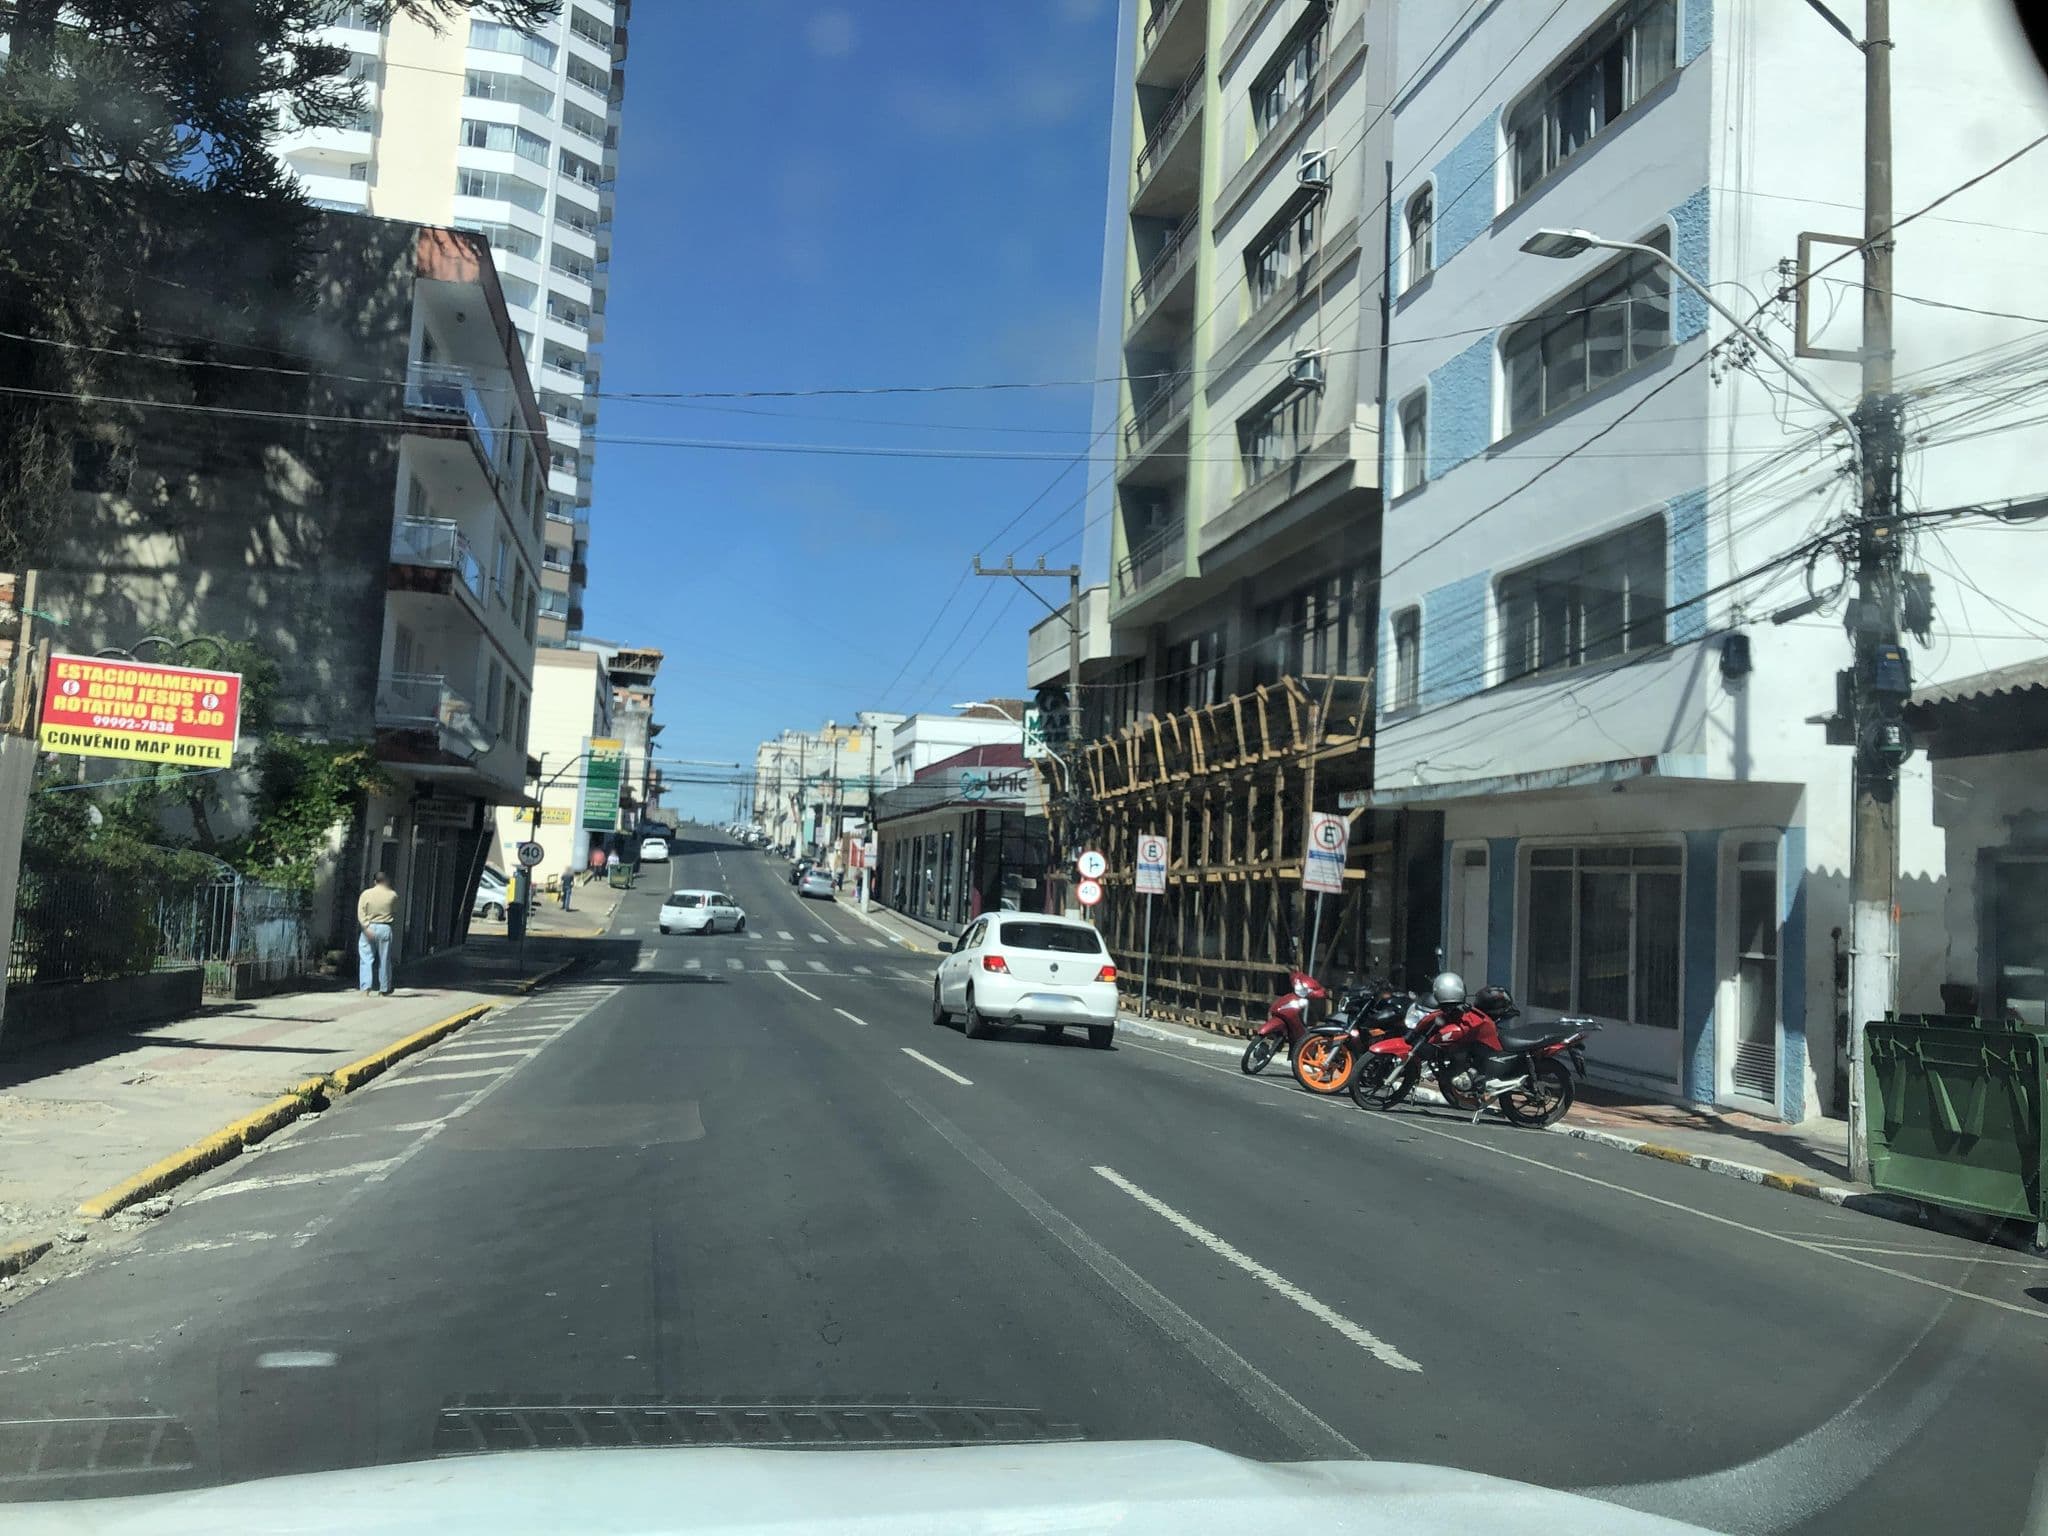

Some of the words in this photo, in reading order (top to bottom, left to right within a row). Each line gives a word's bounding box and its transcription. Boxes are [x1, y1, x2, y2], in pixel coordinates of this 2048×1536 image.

[57, 663, 228, 695] ESTACIONAMENTO
[88, 683, 135, 702] BOM
[137, 687, 194, 708] JESUS
[53, 695, 147, 719] ROTATIVO
[181, 708, 225, 726] 3,00
[47, 731, 130, 751] CONVÊNIO
[135, 739, 170, 754] MAP
[175, 743, 222, 760] HOTEL
[1324, 826, 1336, 843] E
[522, 847, 540, 858] 40
[1148, 845, 1157, 857] E
[1082, 886, 1097, 896] 40
